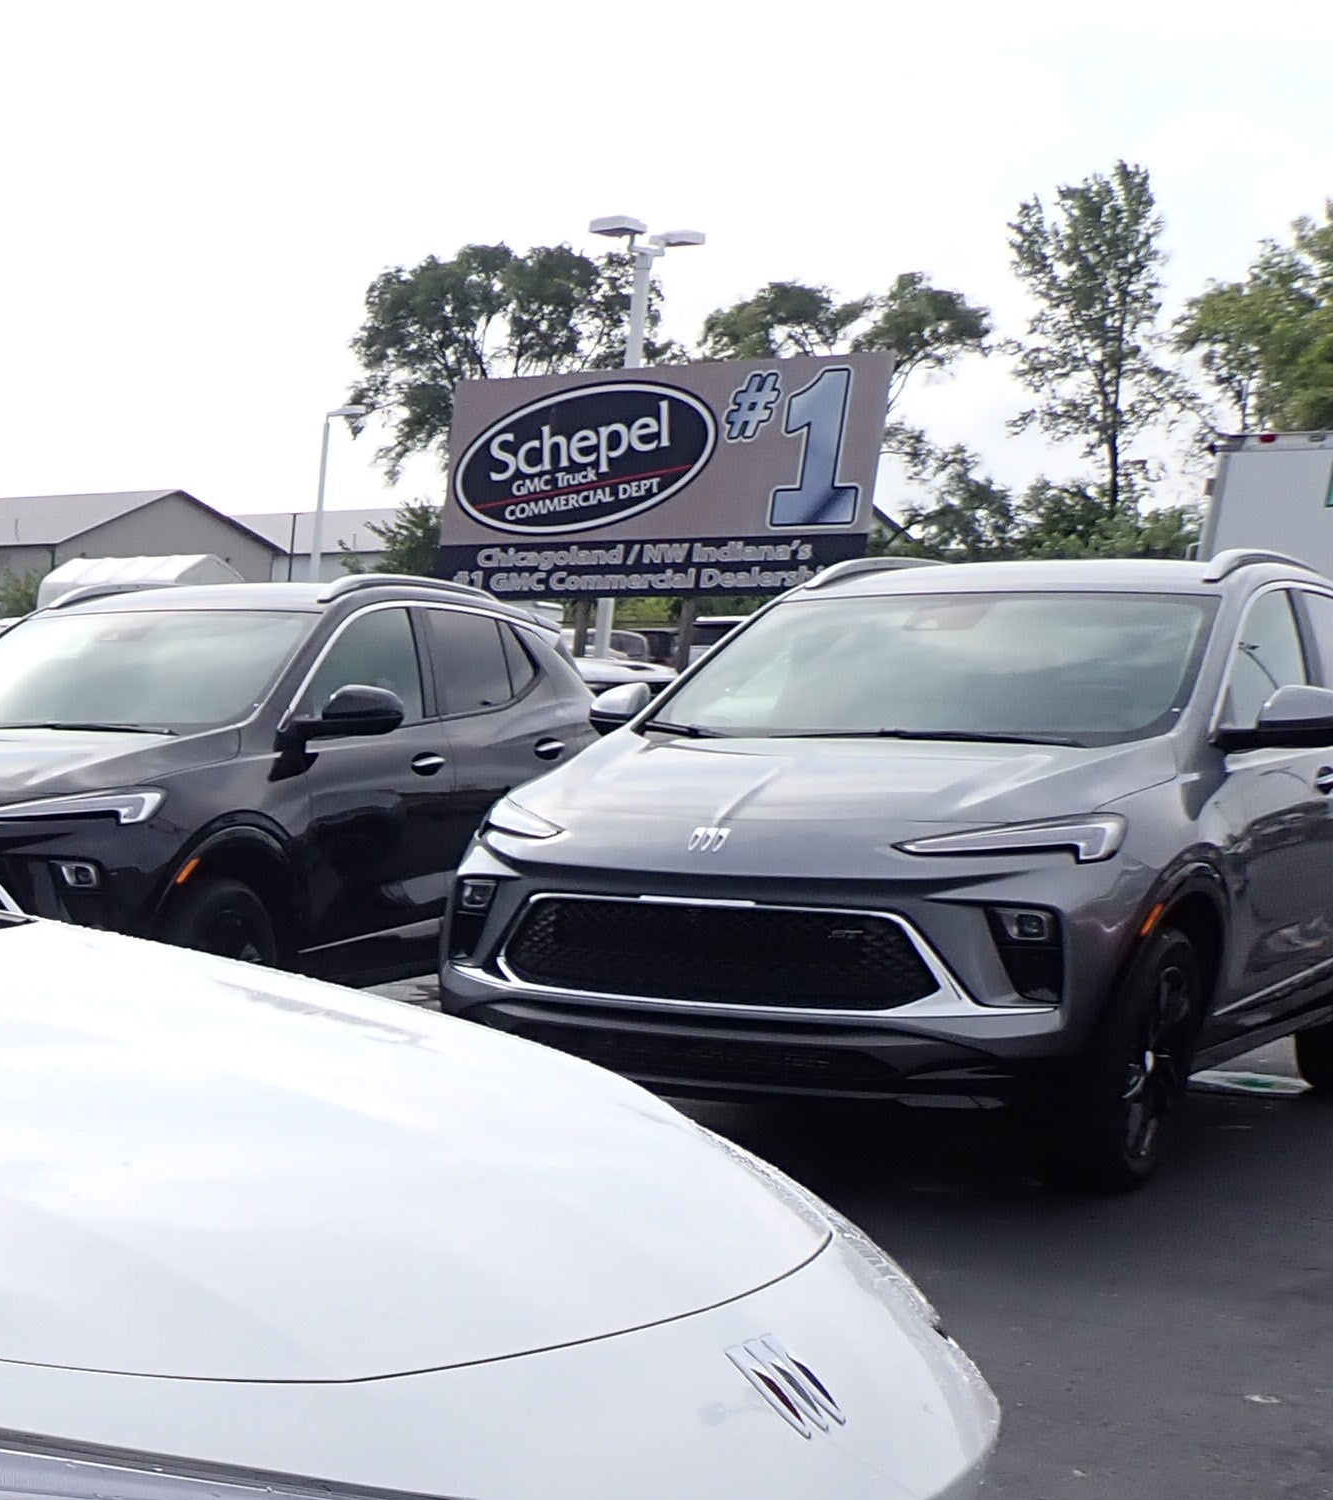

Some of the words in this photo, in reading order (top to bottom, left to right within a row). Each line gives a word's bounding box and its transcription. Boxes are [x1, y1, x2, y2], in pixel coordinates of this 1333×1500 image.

[489, 401, 671, 482] Schepel
[725, 366, 860, 529] #1
[505, 488, 615, 521] COMMERCIAL
[618, 478, 661, 500] DEPT
[512, 475, 552, 497] GMC
[554, 467, 598, 489] Truck
[476, 544, 625, 570] Chicagoland
[625, 544, 641, 565] /
[642, 542, 690, 564] NW
[692, 539, 813, 563] Indiana's
[489, 571, 547, 592] GMC
[549, 566, 696, 591] Commercial
[699, 565, 825, 589] Dealersh
